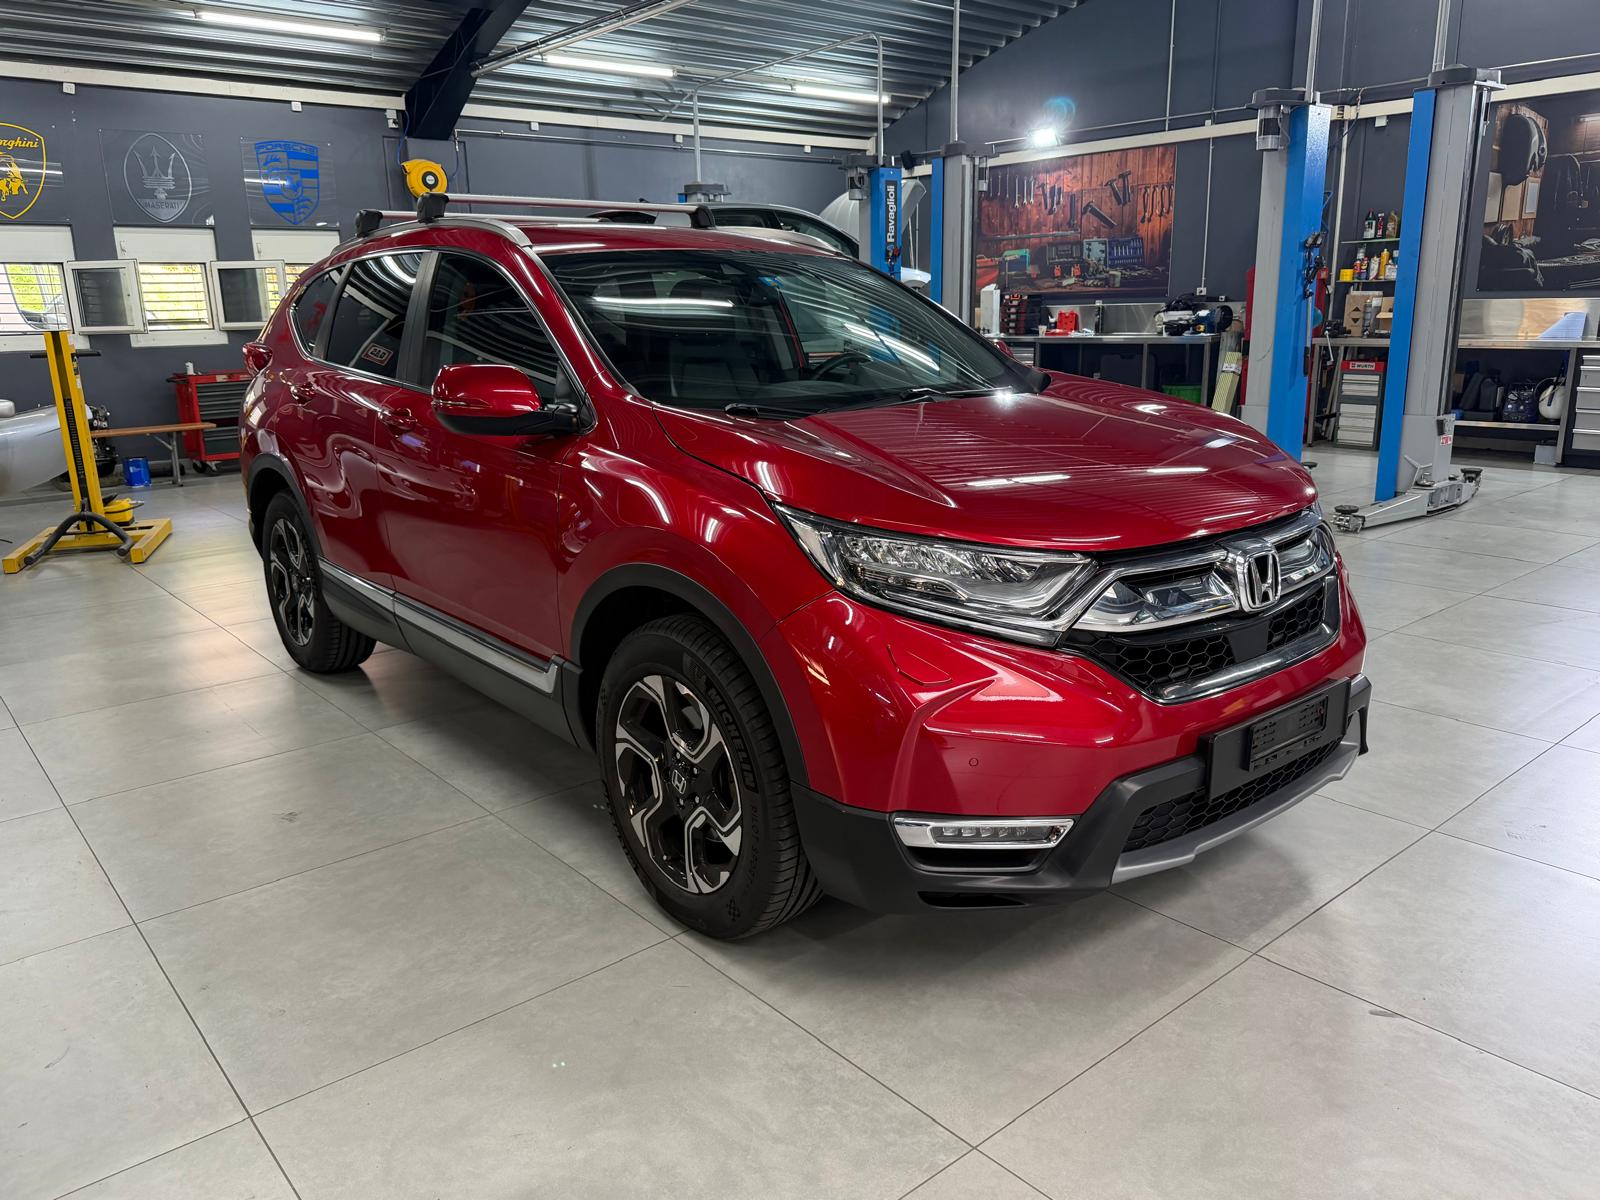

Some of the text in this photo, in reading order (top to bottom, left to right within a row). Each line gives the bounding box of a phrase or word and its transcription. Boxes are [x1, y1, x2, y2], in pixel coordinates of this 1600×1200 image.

[256, 143, 316, 156] PORSCHE
[144, 201, 179, 209] MASERATI
[887, 185, 896, 242] Ravaglioli
[706, 688, 758, 792] MICHELIN
